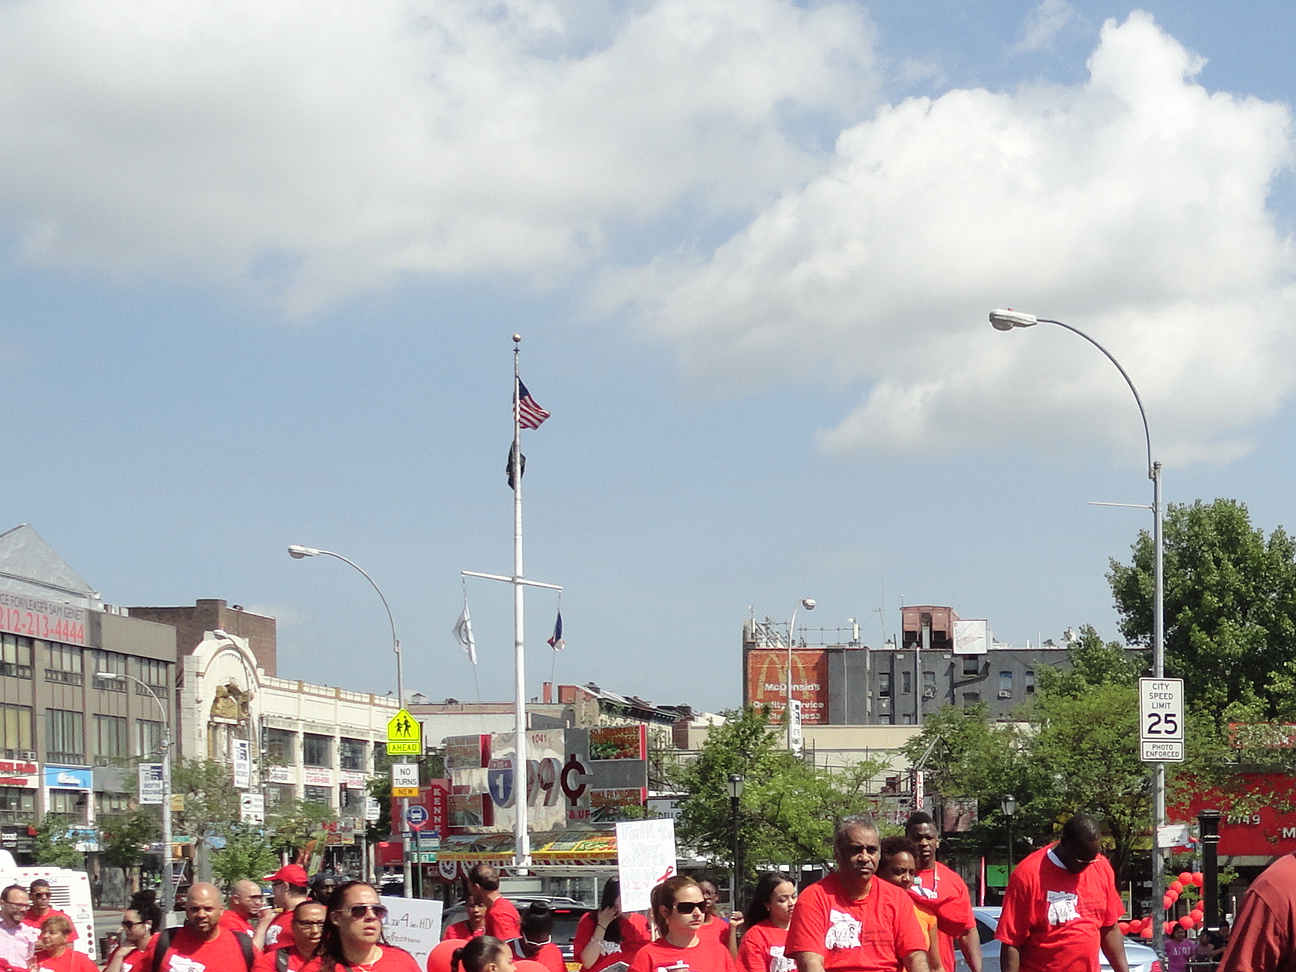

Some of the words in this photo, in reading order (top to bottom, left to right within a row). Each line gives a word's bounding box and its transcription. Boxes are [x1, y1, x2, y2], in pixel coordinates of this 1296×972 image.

[1149, 692, 1173, 700] SPEED
[1147, 712, 1178, 735] 25
[532, 734, 547, 744] 1041
[392, 744, 417, 752] AHEAD
[400, 768, 411, 776] NO
[395, 778, 417, 786] TURNS
[580, 810, 590, 819] UP
[400, 913, 409, 927] 4
[420, 917, 434, 930] HIV
